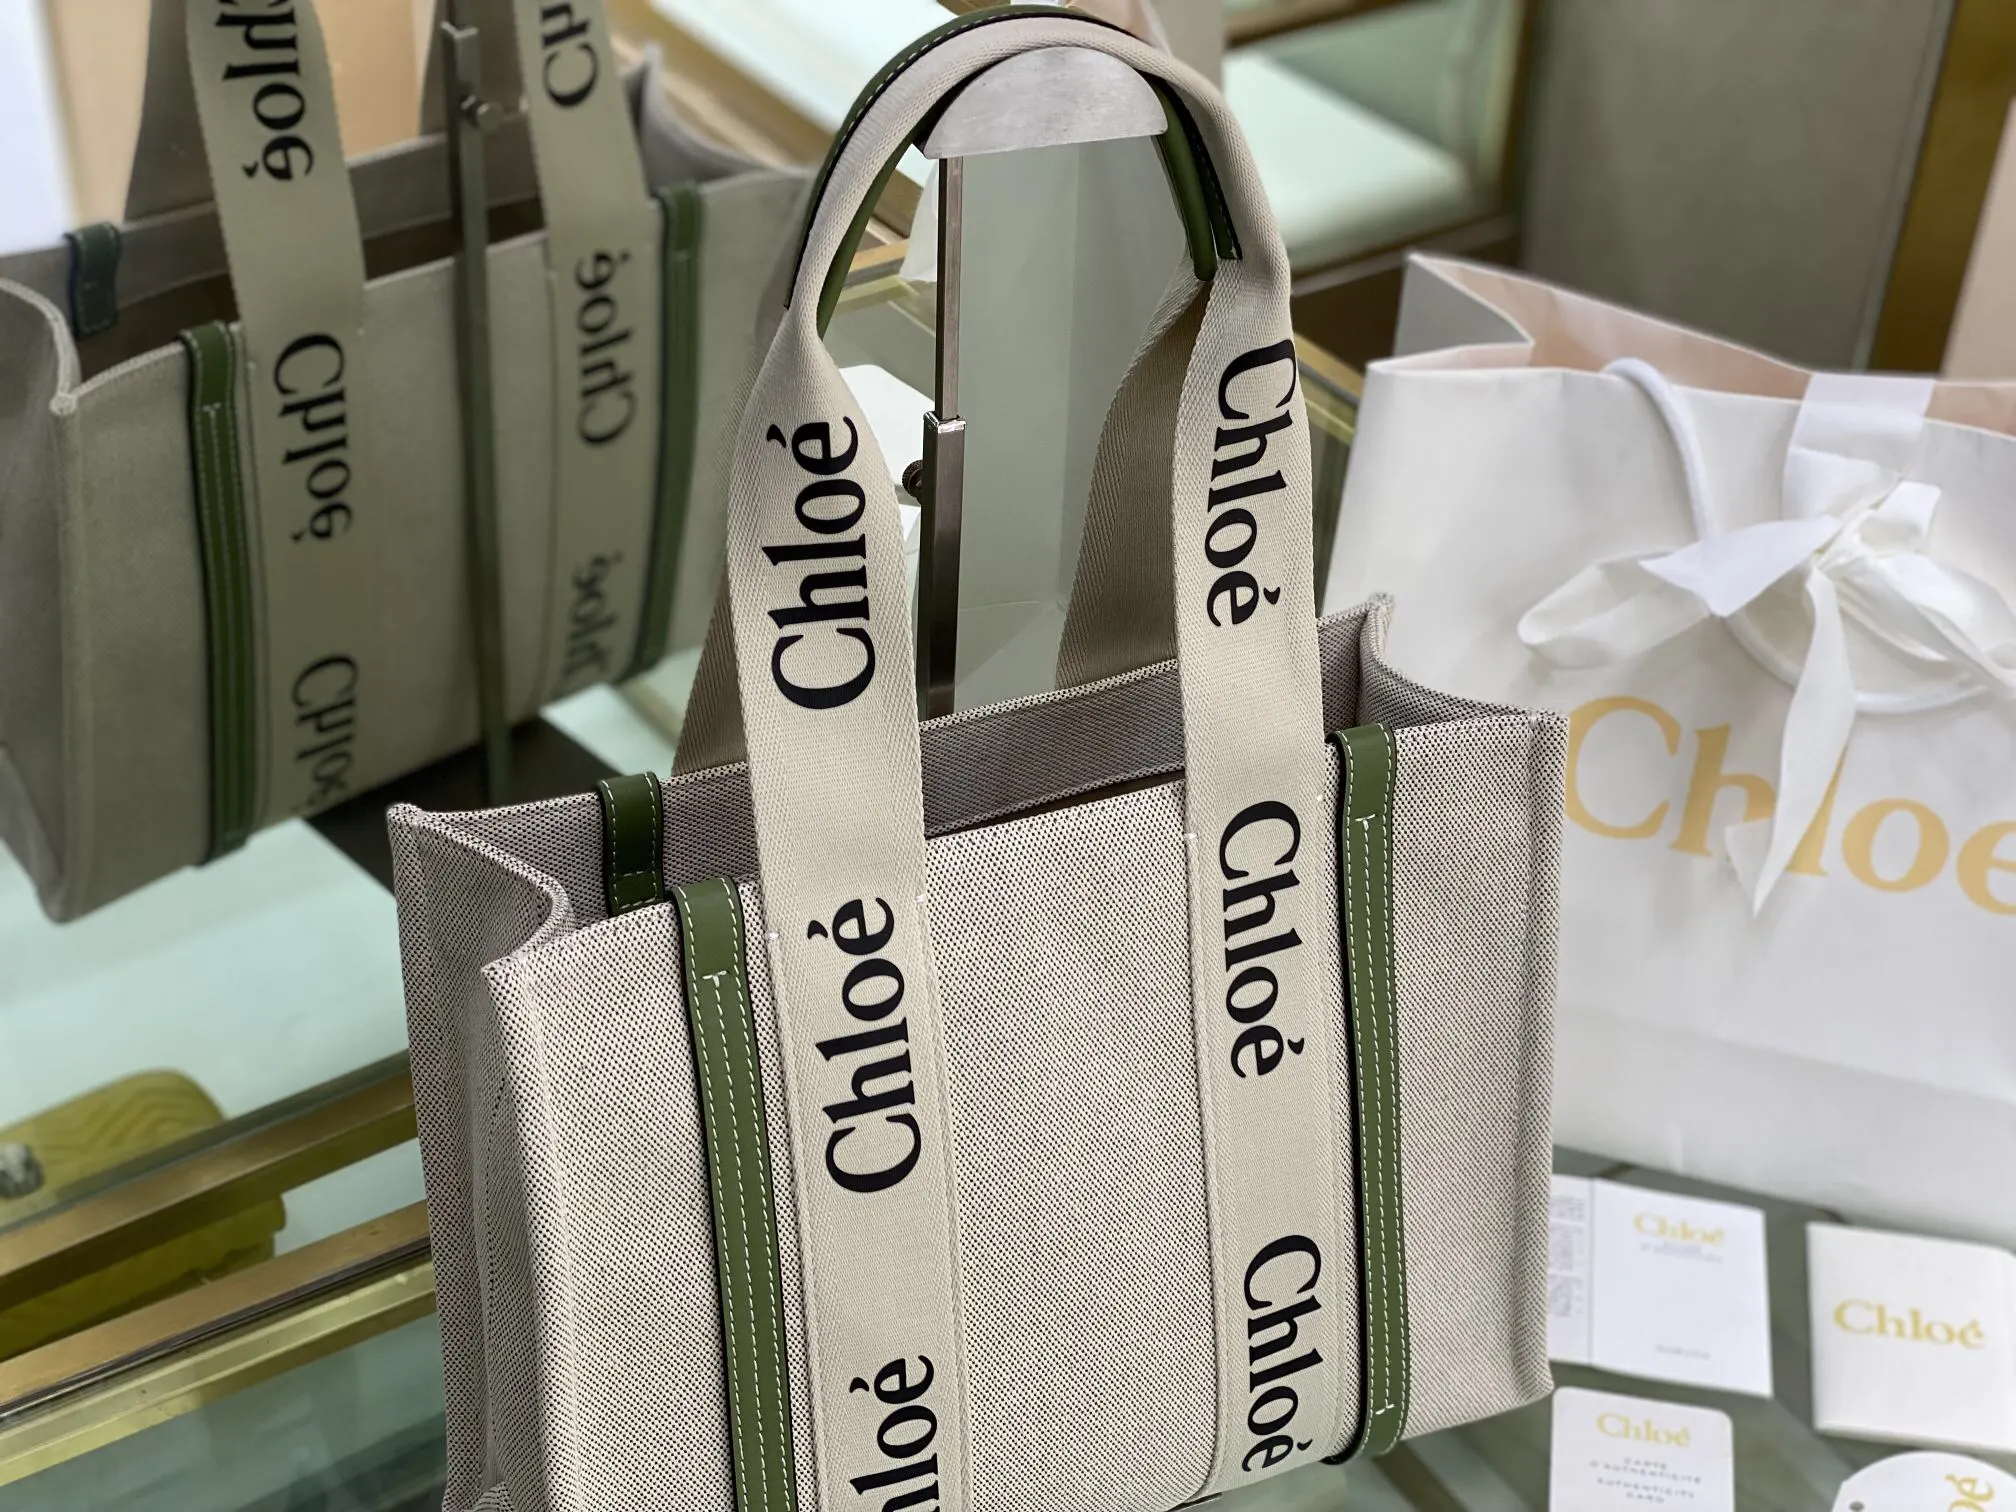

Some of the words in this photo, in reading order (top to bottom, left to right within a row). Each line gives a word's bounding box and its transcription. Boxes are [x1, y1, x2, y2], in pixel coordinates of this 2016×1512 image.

[762, 416, 876, 710] Chloé
[1204, 338, 1297, 627] Chloé
[807, 897, 922, 1193] Chloé
[1219, 801, 1305, 1079] Chloé
[849, 1355, 940, 1512] loé
[1242, 1235, 1324, 1472] Chloé
[1833, 1298, 1986, 1351] Chloé
